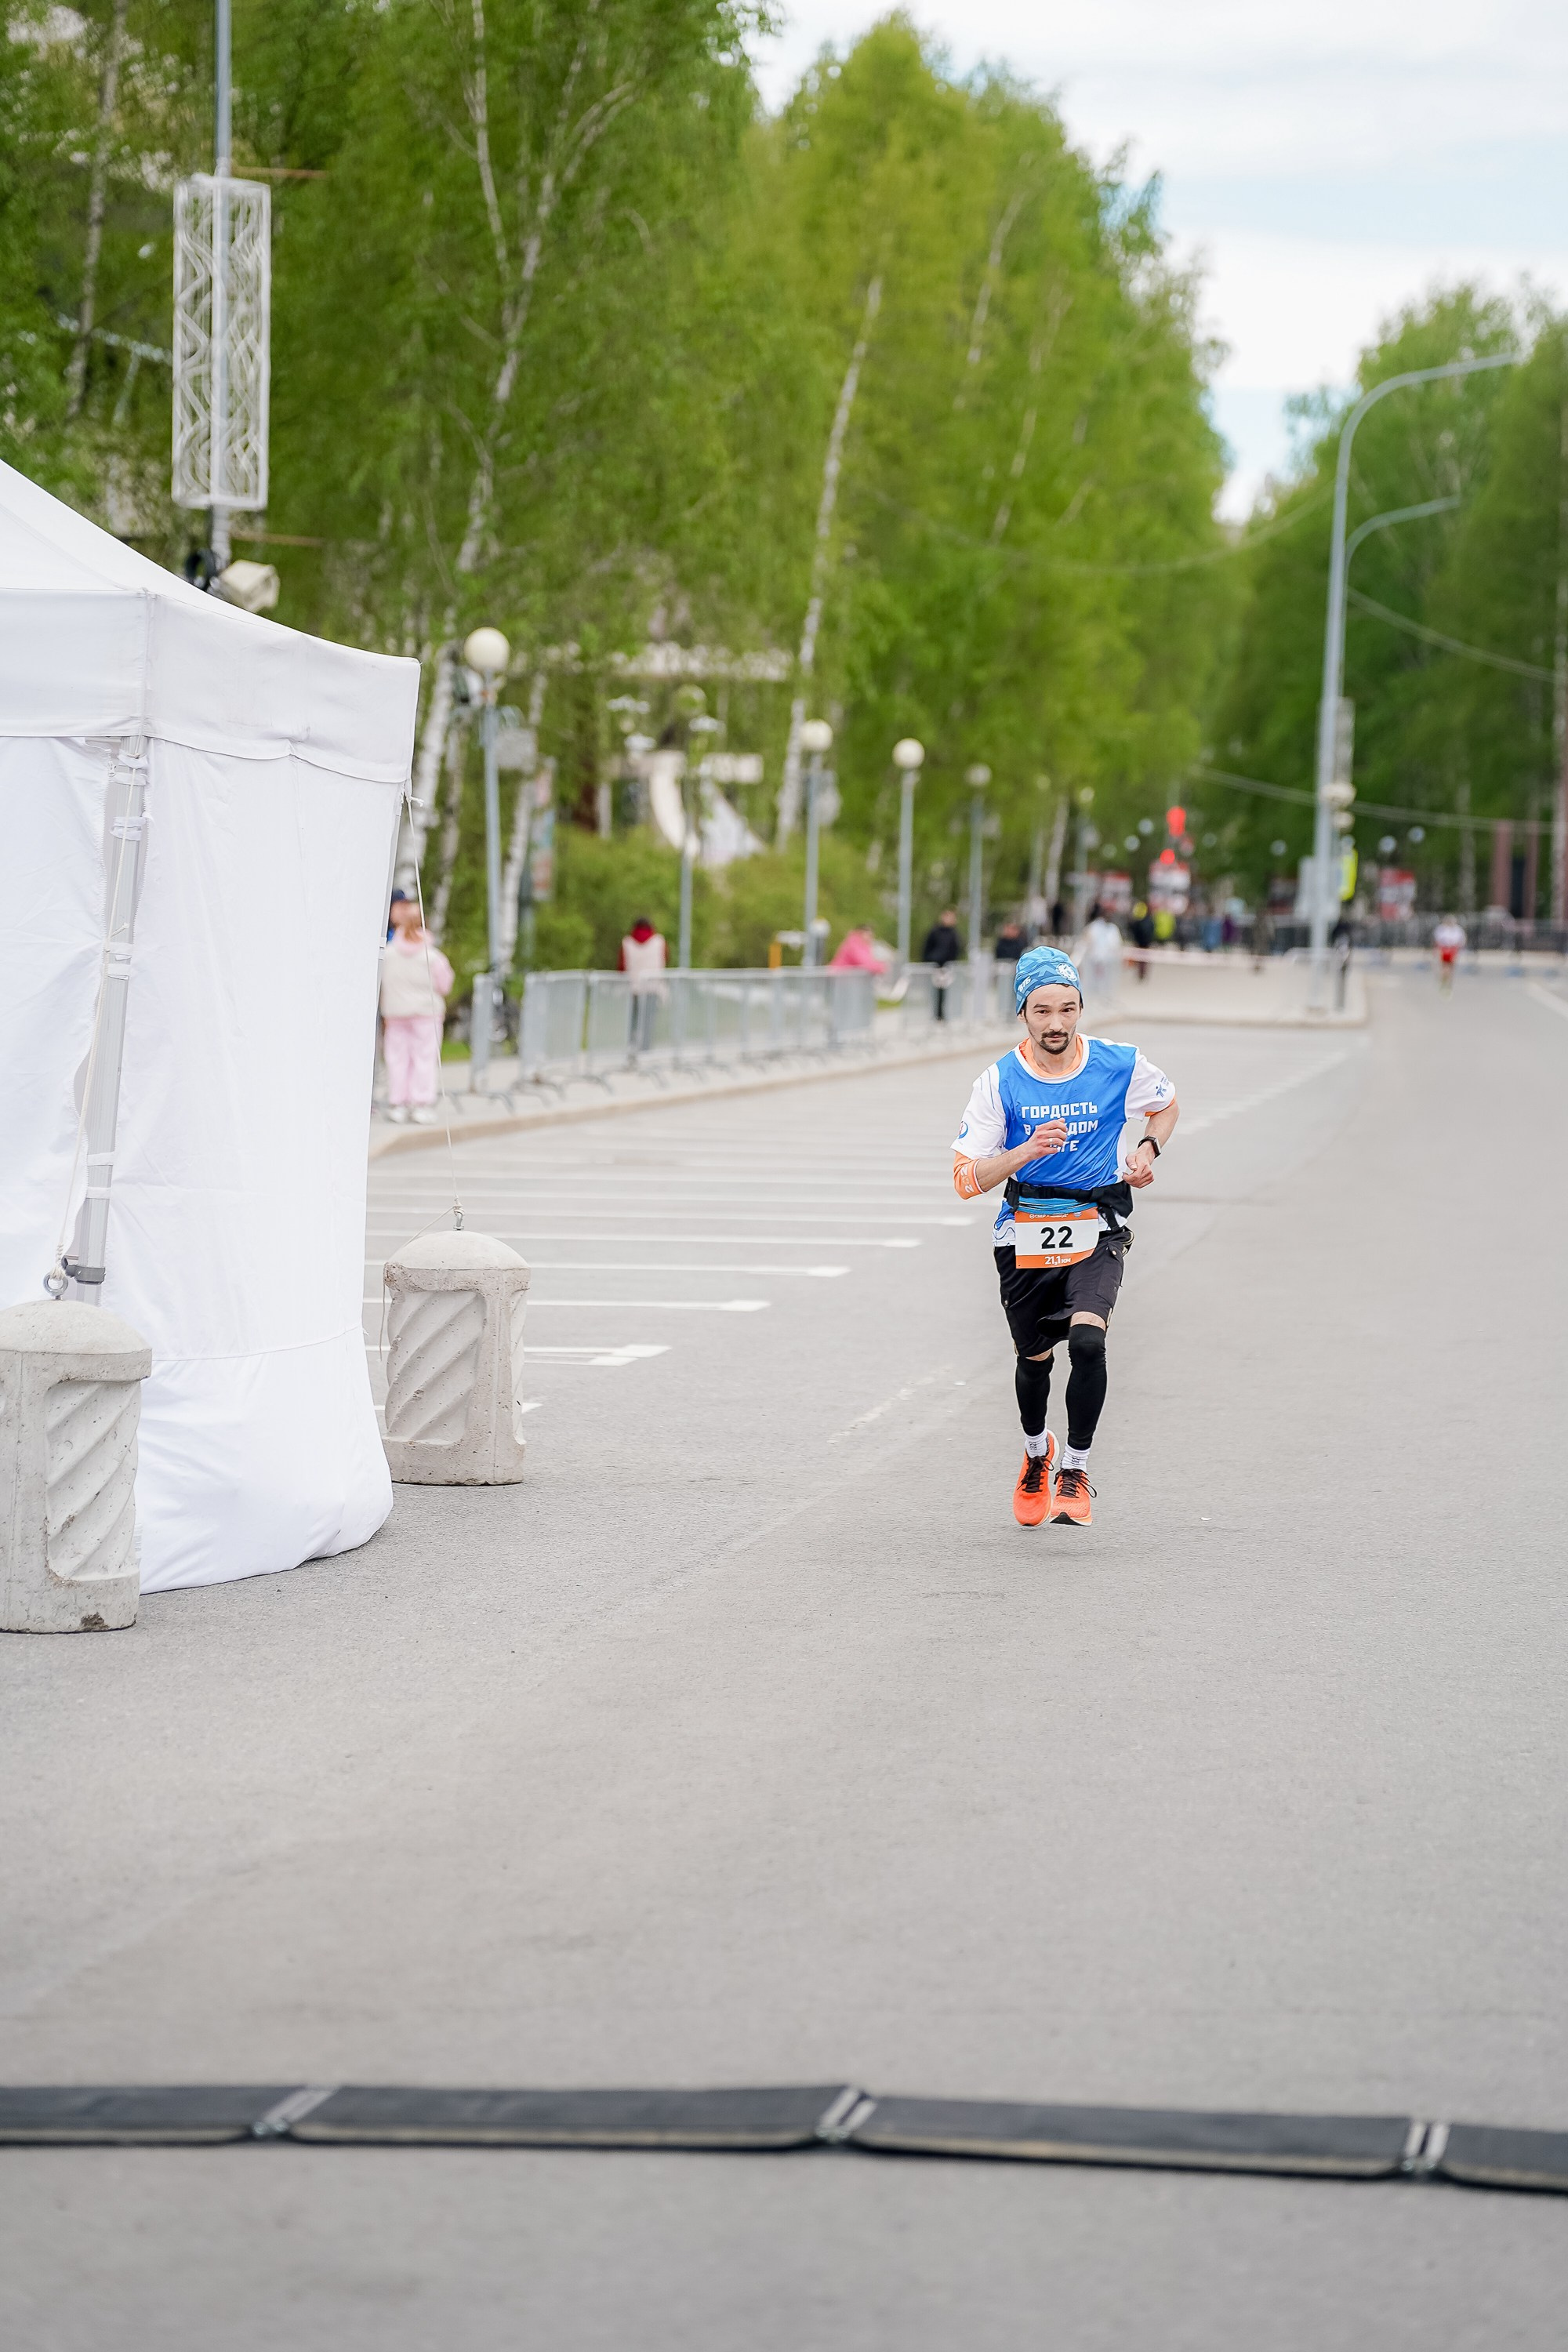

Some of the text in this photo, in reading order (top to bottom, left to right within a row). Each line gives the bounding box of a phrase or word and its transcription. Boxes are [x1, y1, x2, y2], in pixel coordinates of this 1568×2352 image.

[1021, 1101, 1098, 1119] ГОРДОСТЬ
[1023, 1123, 1032, 1136] В
[1040, 1225, 1073, 1250] 22
